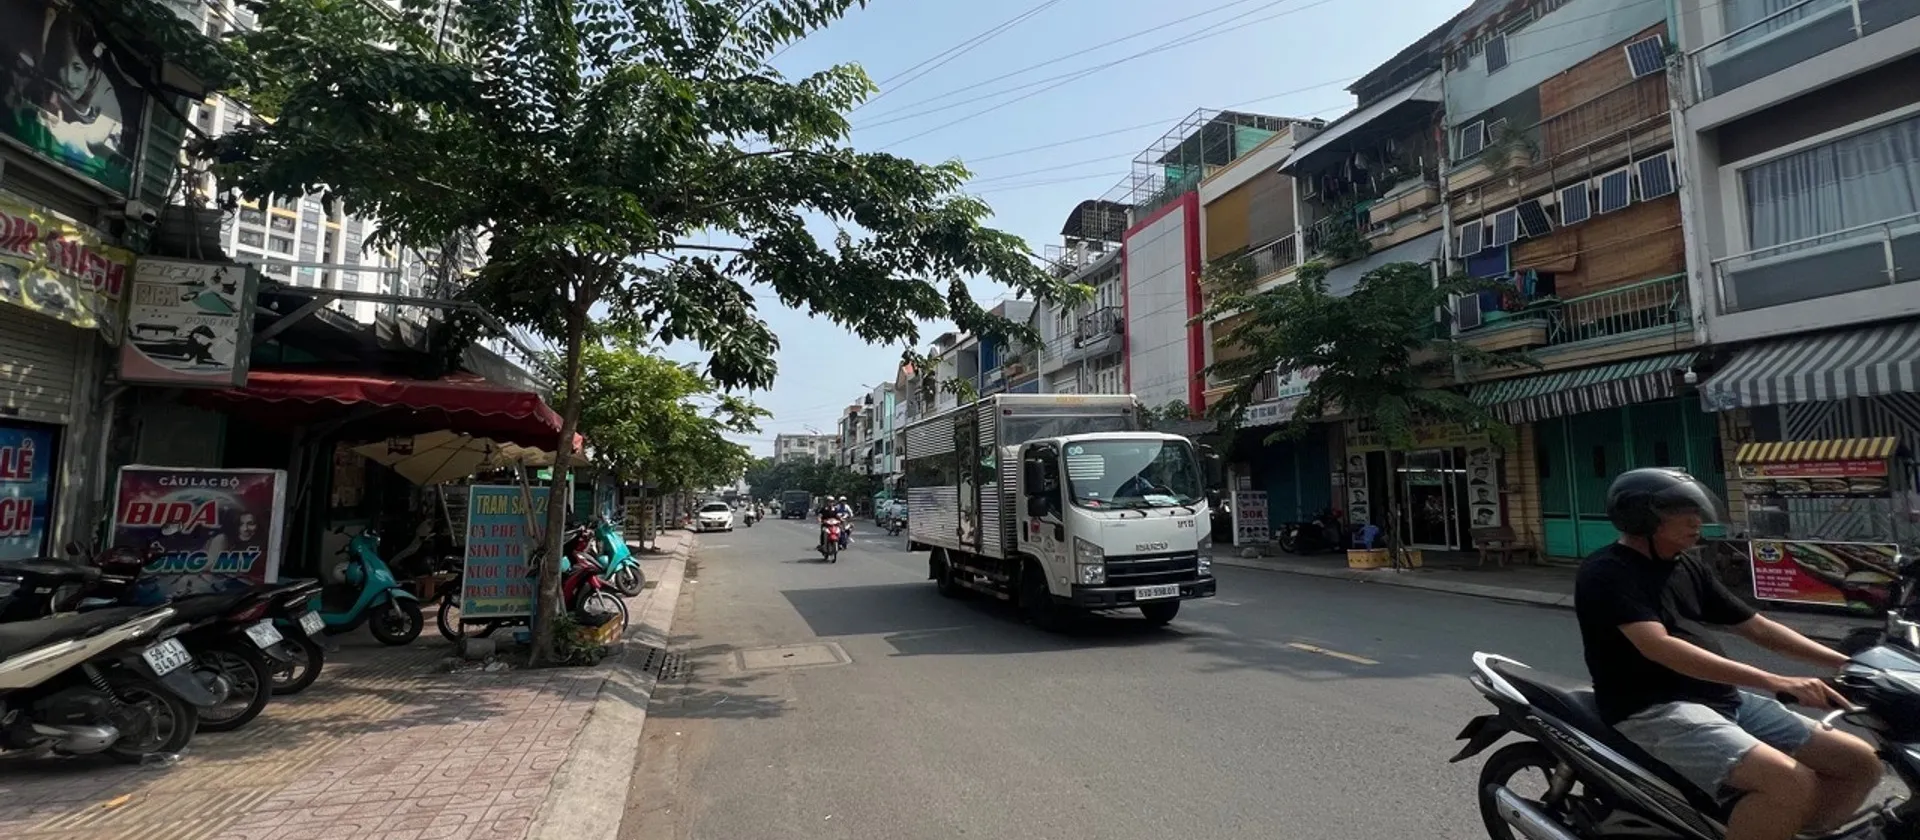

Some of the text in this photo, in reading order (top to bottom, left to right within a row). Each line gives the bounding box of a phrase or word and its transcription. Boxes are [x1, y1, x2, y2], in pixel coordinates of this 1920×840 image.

[190, 477, 218, 489] LẠC
[220, 476, 240, 490] BỘ
[125, 499, 219, 532] BIDA
[1135, 542, 1168, 552] ISUZU
[211, 546, 262, 573] MỸ
